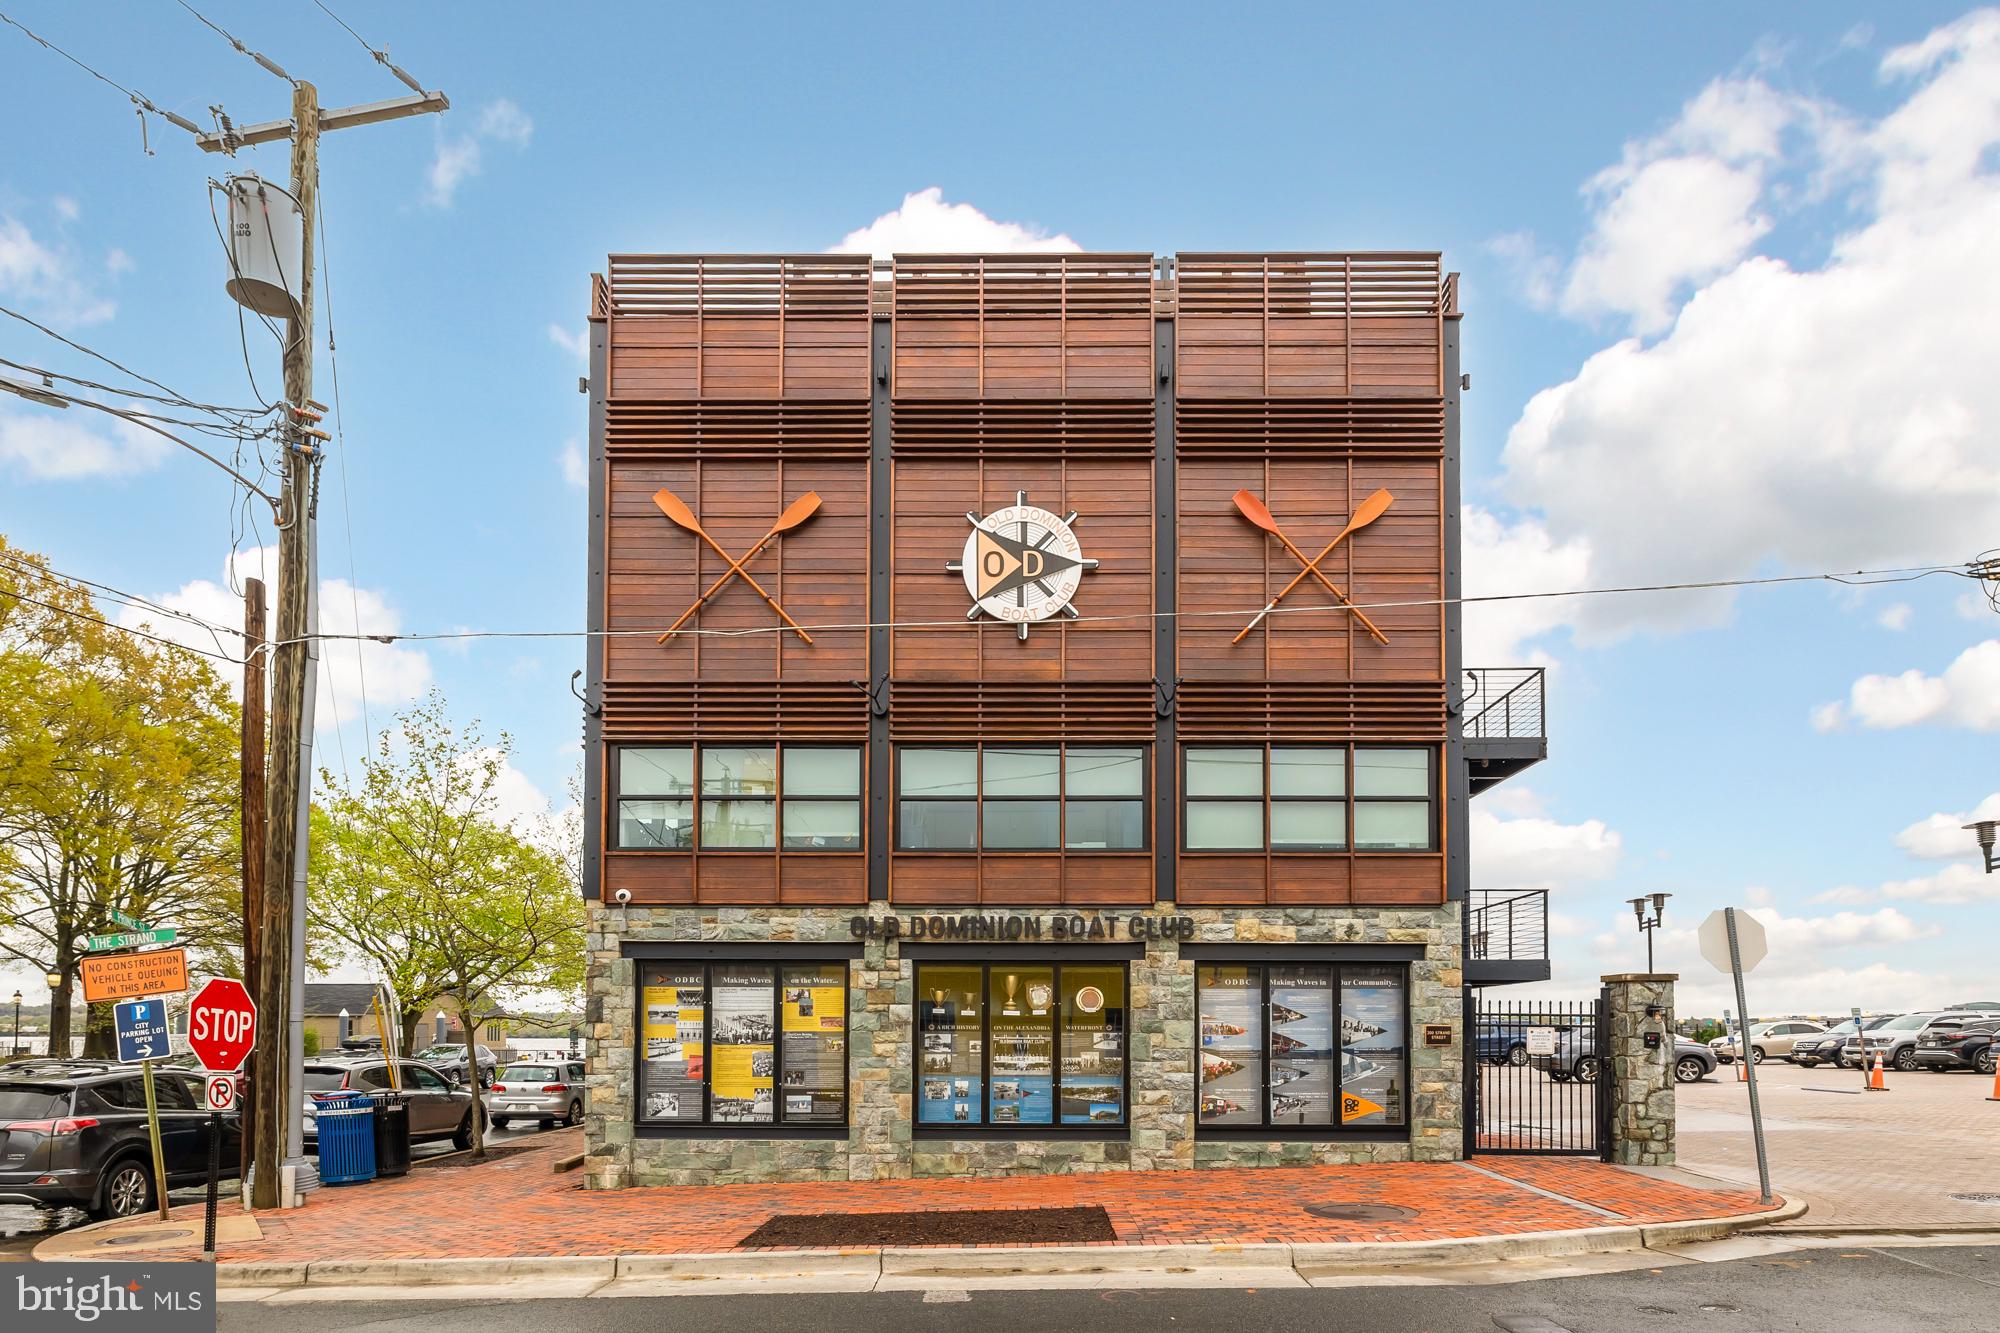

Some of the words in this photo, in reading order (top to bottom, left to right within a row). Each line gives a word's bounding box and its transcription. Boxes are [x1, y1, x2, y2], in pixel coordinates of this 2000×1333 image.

[986, 509, 1014, 529] OLD
[1020, 508, 1078, 553] DOMINION
[1002, 606, 1038, 621] BOAT
[1045, 582, 1075, 613] CLUB
[850, 916, 900, 938] OLD
[910, 916, 1042, 938] DOMINION
[1052, 916, 1120, 939] BOAT
[1128, 916, 1195, 939] CLUB
[93, 938, 113, 949] THE
[118, 932, 157, 946] STRAND
[88, 964, 102, 973] NO
[107, 955, 179, 971] CONSTRUCTION
[92, 973, 134, 984] VEHICLE
[137, 967, 178, 980] QUEUING
[722, 976, 749, 985] Making
[749, 976, 772, 984] Waves
[1270, 979, 1296, 987] Making
[107, 985, 116, 995] IN
[120, 983, 140, 993] THIS
[143, 980, 166, 991] AREA
[134, 1005, 146, 1020] P
[121, 1029, 150, 1039] PARKING
[151, 1026, 165, 1036] LOT
[134, 1021, 149, 1030] CITY
[193, 1006, 252, 1043] STOP
[134, 1035, 153, 1044] OPEN
